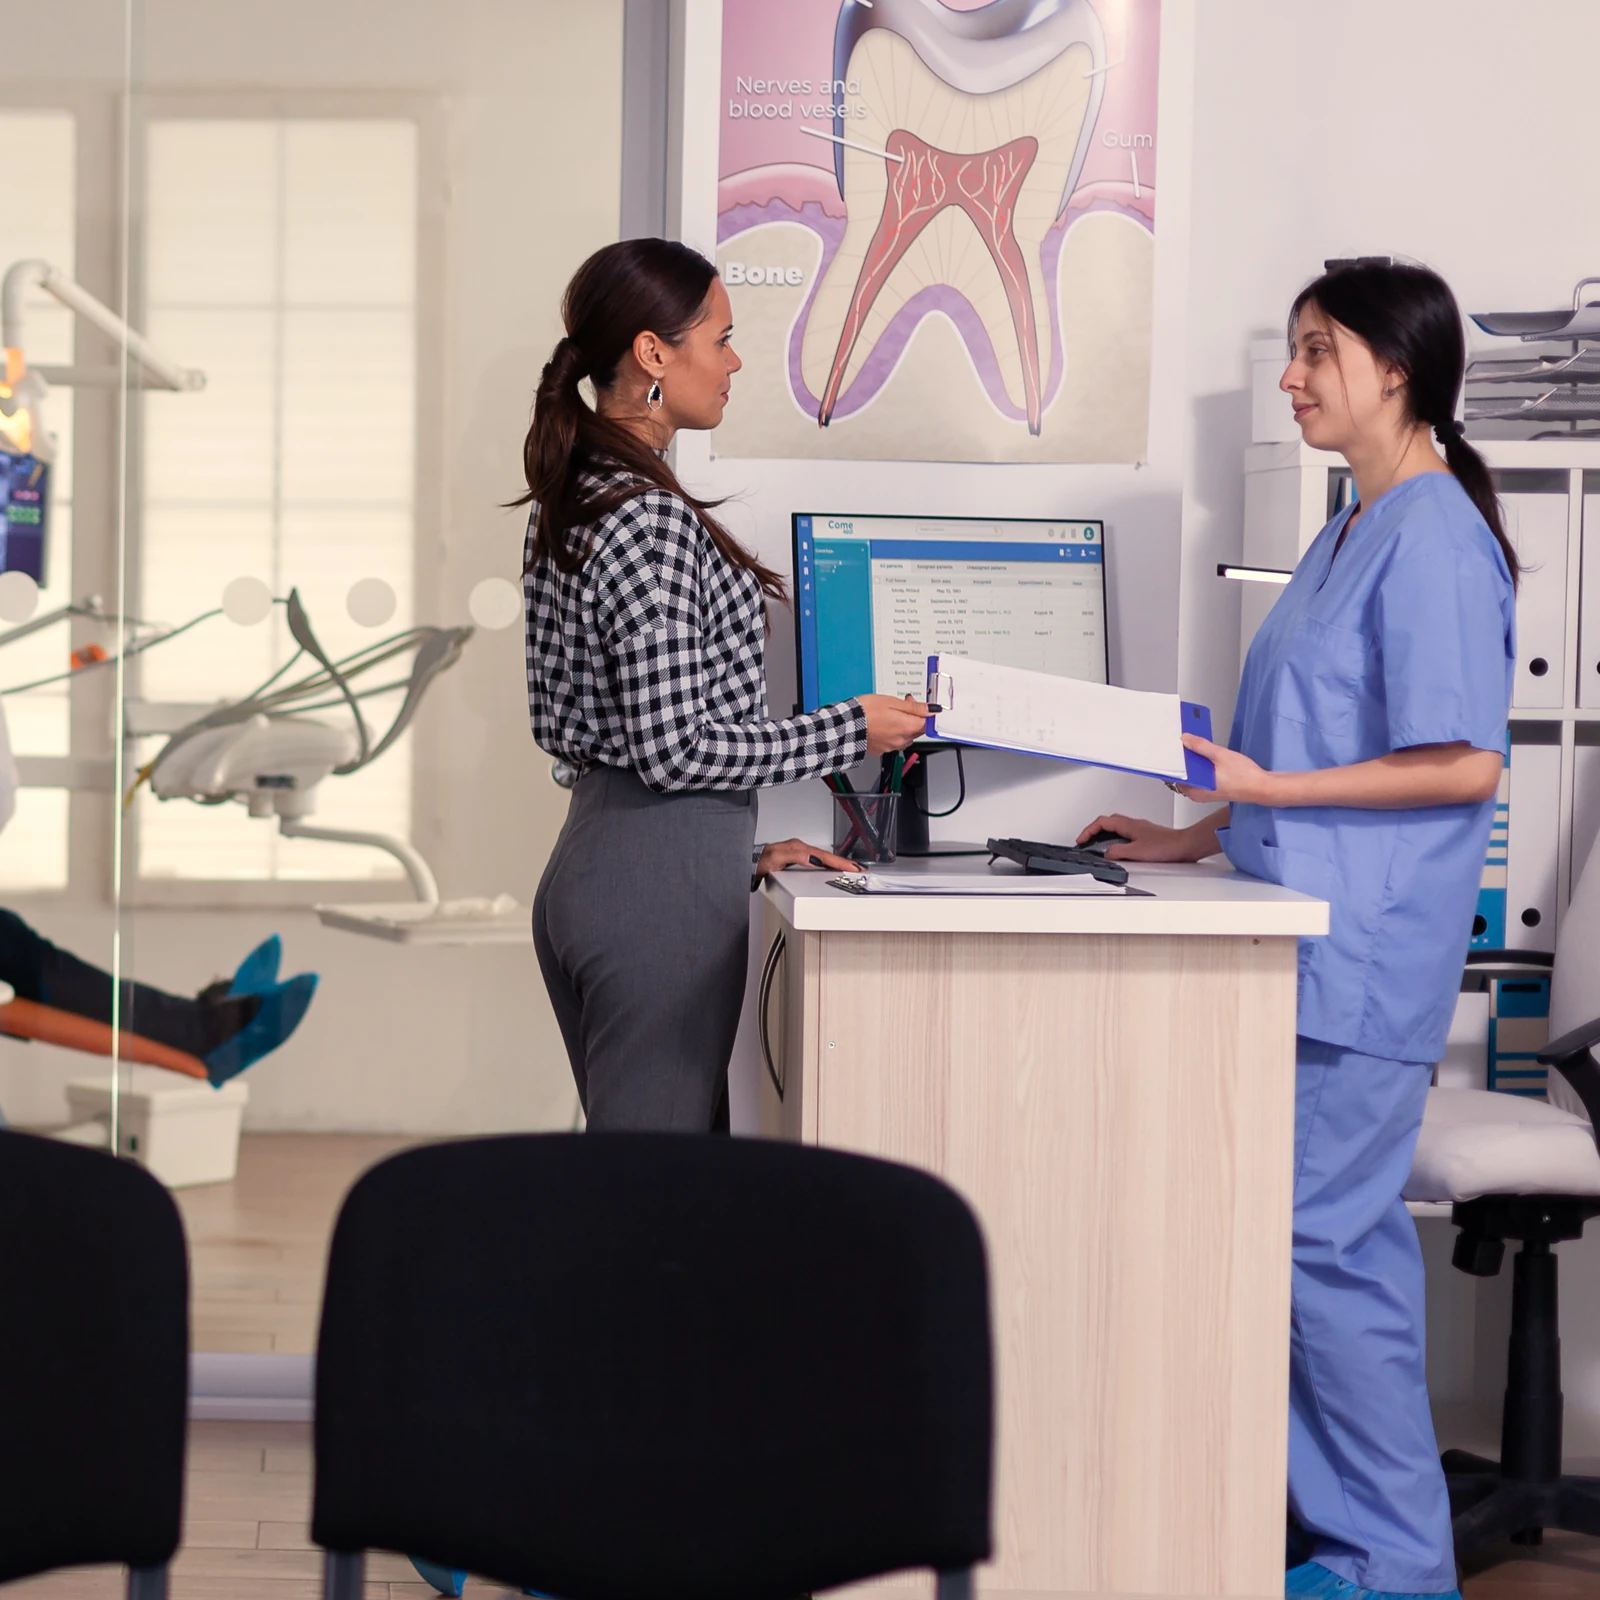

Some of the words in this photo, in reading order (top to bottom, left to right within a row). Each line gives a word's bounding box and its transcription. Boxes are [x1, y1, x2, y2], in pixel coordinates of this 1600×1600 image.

[736, 76, 812, 94] Nerves
[819, 76, 860, 95] and
[729, 99, 793, 119] blood
[800, 100, 867, 119] vesels
[1102, 129, 1153, 148] Gum
[724, 262, 803, 286] Bone
[828, 520, 854, 530] Come
